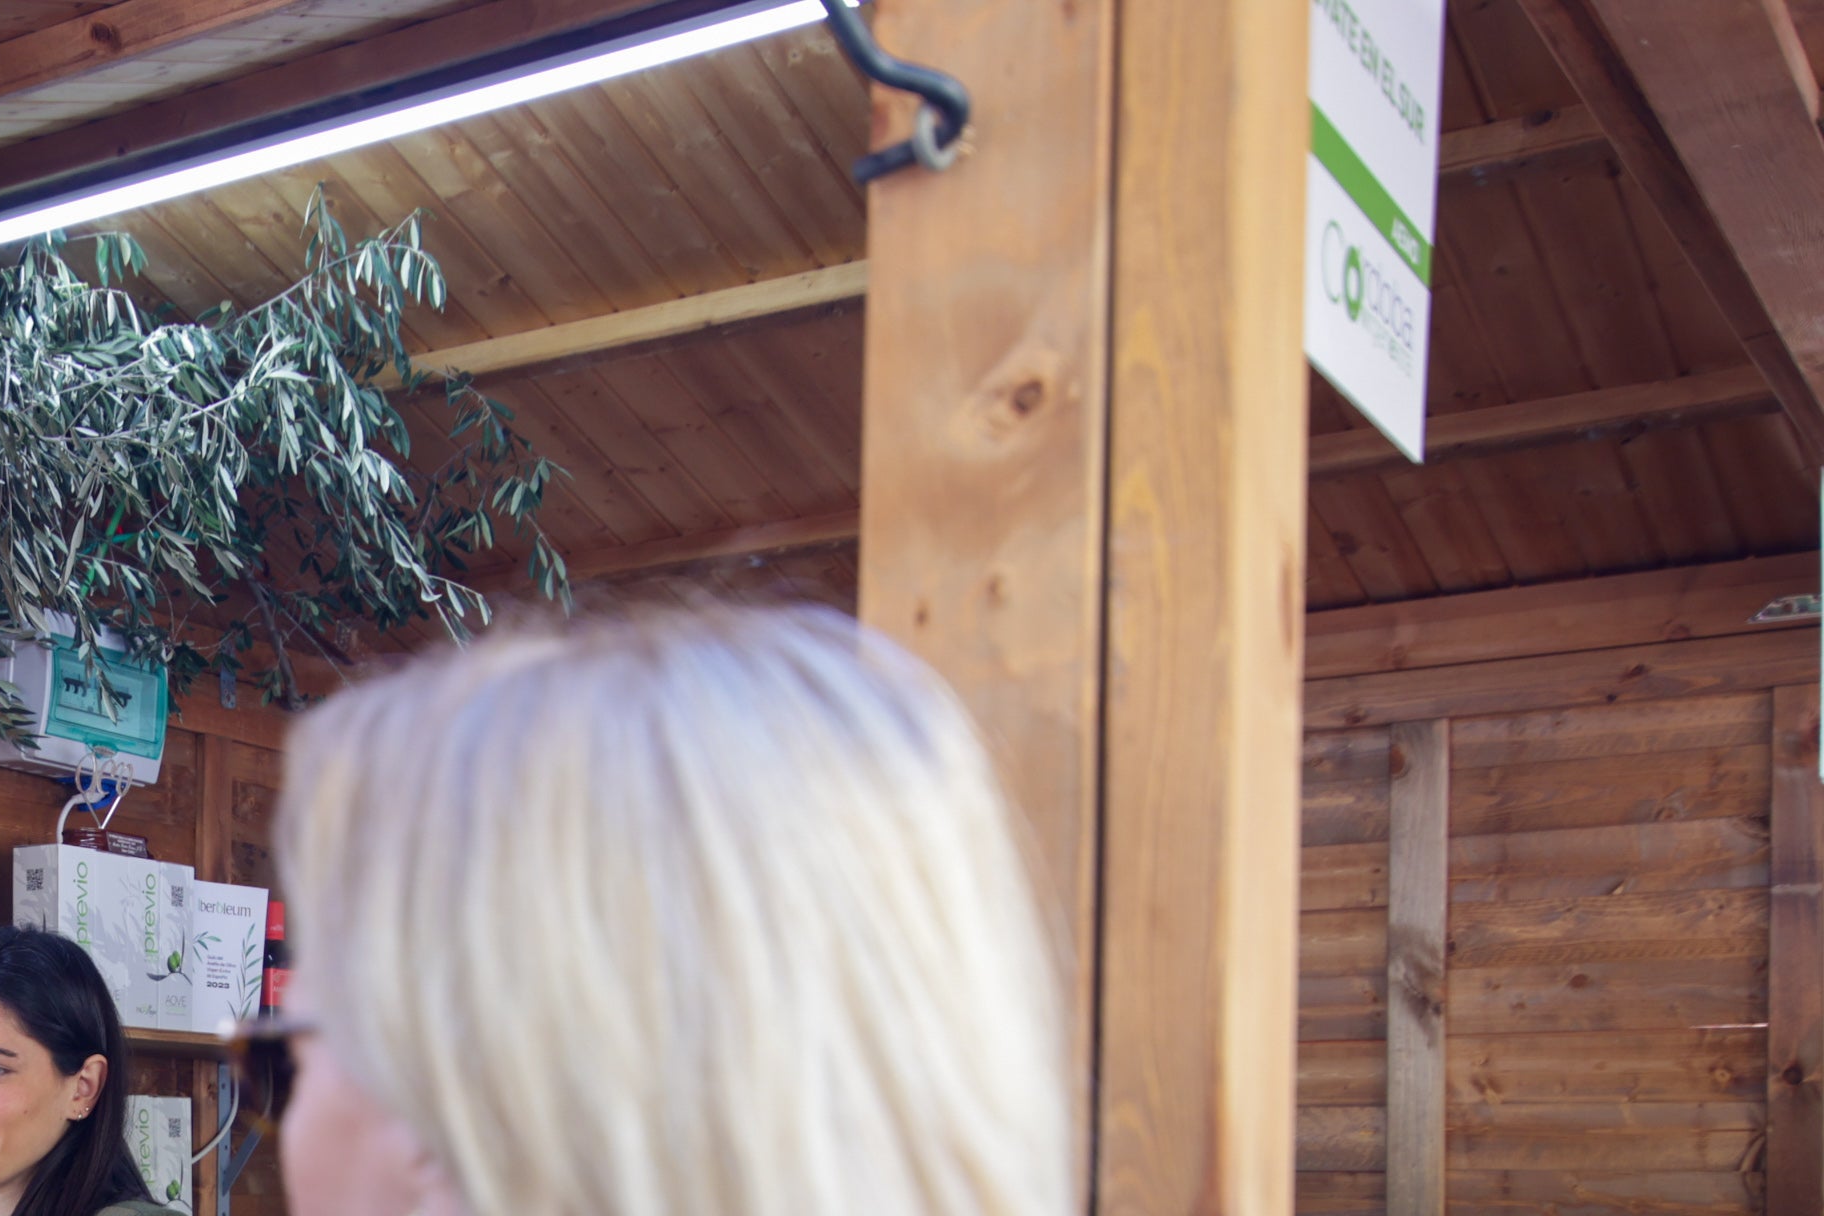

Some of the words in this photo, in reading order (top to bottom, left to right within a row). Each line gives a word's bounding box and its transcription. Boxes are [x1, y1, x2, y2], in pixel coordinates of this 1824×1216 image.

[73, 861, 91, 946] previo
[142, 873, 160, 954] previo
[206, 981, 231, 990] 2023
[136, 1108, 156, 1186] previo
